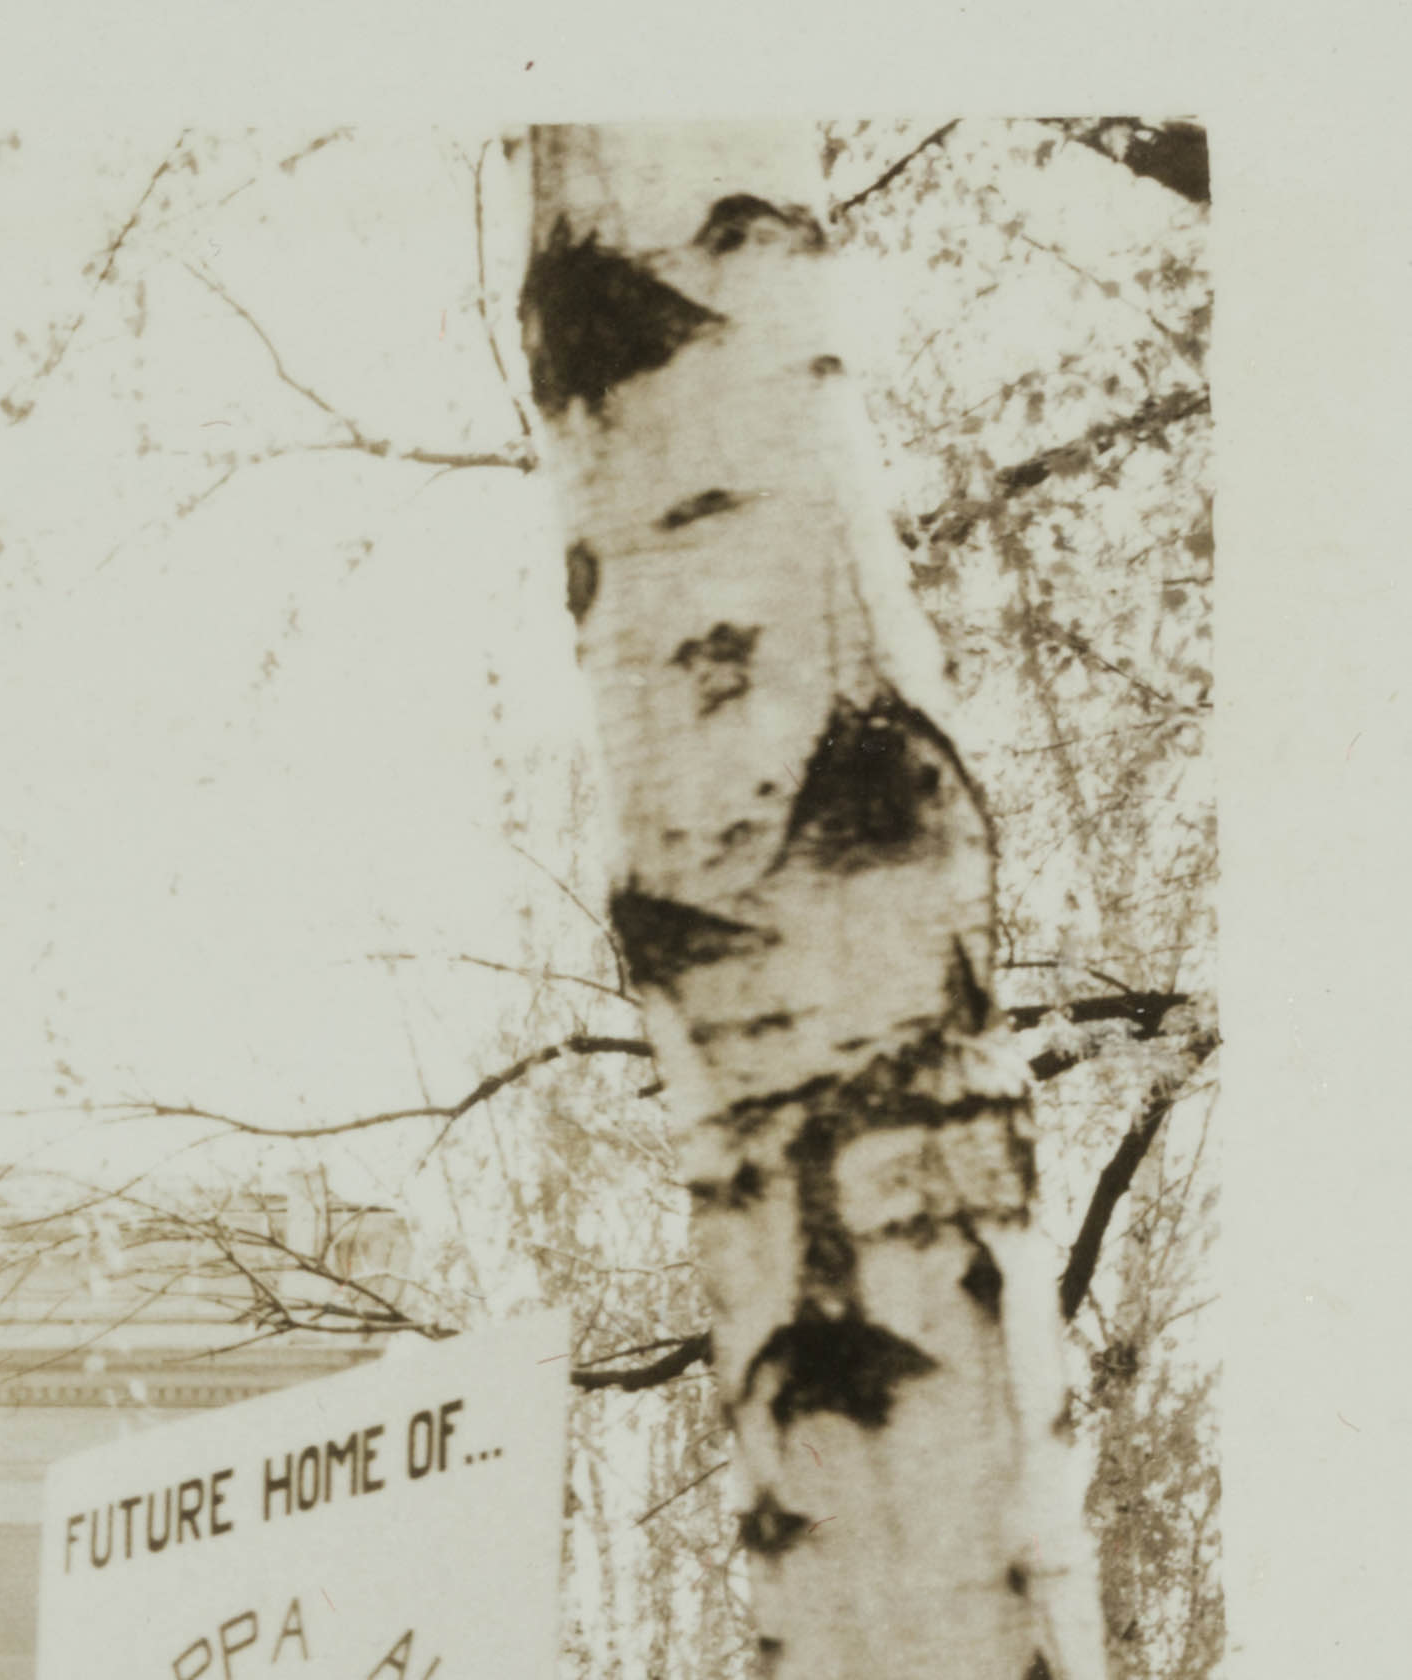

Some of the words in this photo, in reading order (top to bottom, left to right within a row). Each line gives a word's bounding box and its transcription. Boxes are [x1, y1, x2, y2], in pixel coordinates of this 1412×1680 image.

[64, 1467, 234, 1575] FUTURE
[261, 1424, 386, 1522] HOME
[408, 1399, 504, 1480] OF...
